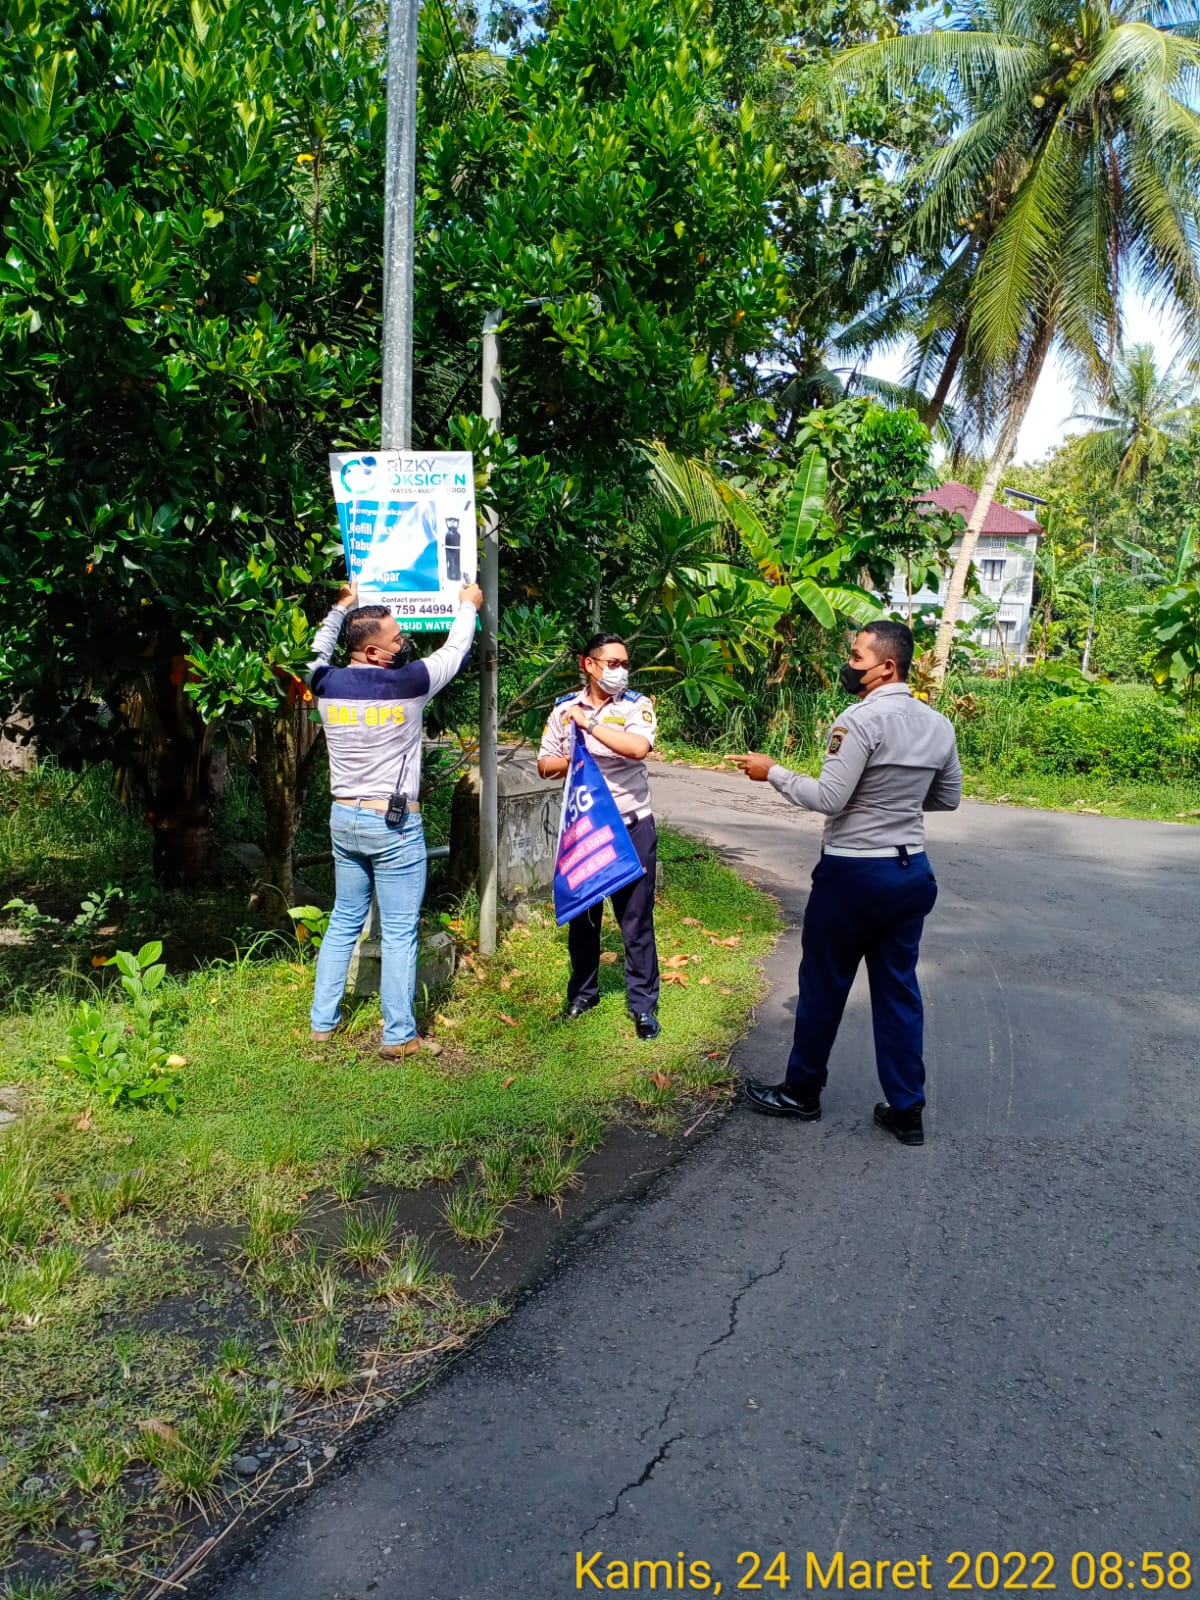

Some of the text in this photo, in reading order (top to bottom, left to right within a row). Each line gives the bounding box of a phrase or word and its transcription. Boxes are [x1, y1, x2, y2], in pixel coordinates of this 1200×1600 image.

[387, 458, 436, 473] RIZKY
[395, 604, 416, 615] 759
[418, 603, 454, 615] 44994
[425, 621, 453, 632] WATE
[364, 705, 406, 727] OPS
